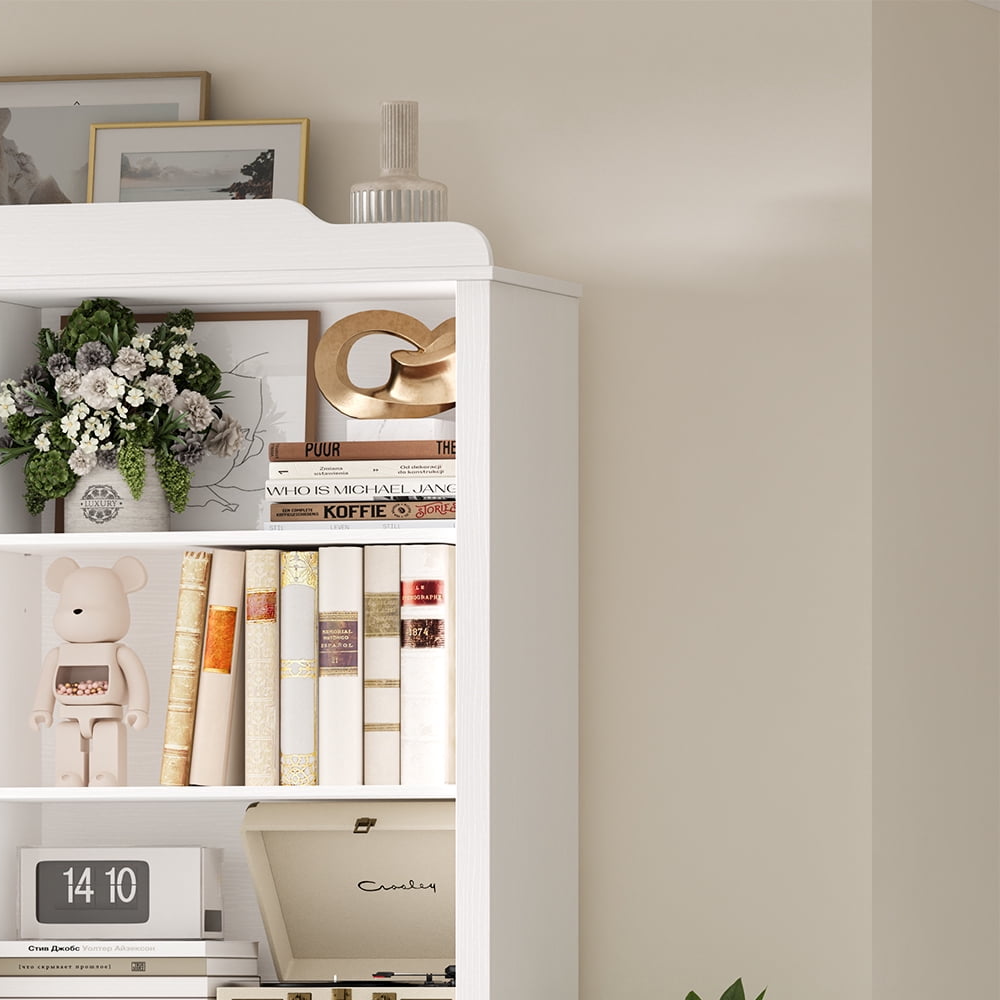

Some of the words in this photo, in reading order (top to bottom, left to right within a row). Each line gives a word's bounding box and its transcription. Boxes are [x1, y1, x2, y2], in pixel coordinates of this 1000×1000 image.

[305, 442, 340, 457] PUUR
[436, 441, 456, 454] THE
[267, 486, 310, 496] WHO
[315, 486, 330, 495] IS
[334, 484, 410, 494] MICHAEL
[324, 504, 386, 518] KOFFIE
[63, 867, 94, 903] 14
[105, 867, 137, 903] 10
[358, 880, 436, 893] Crosley
